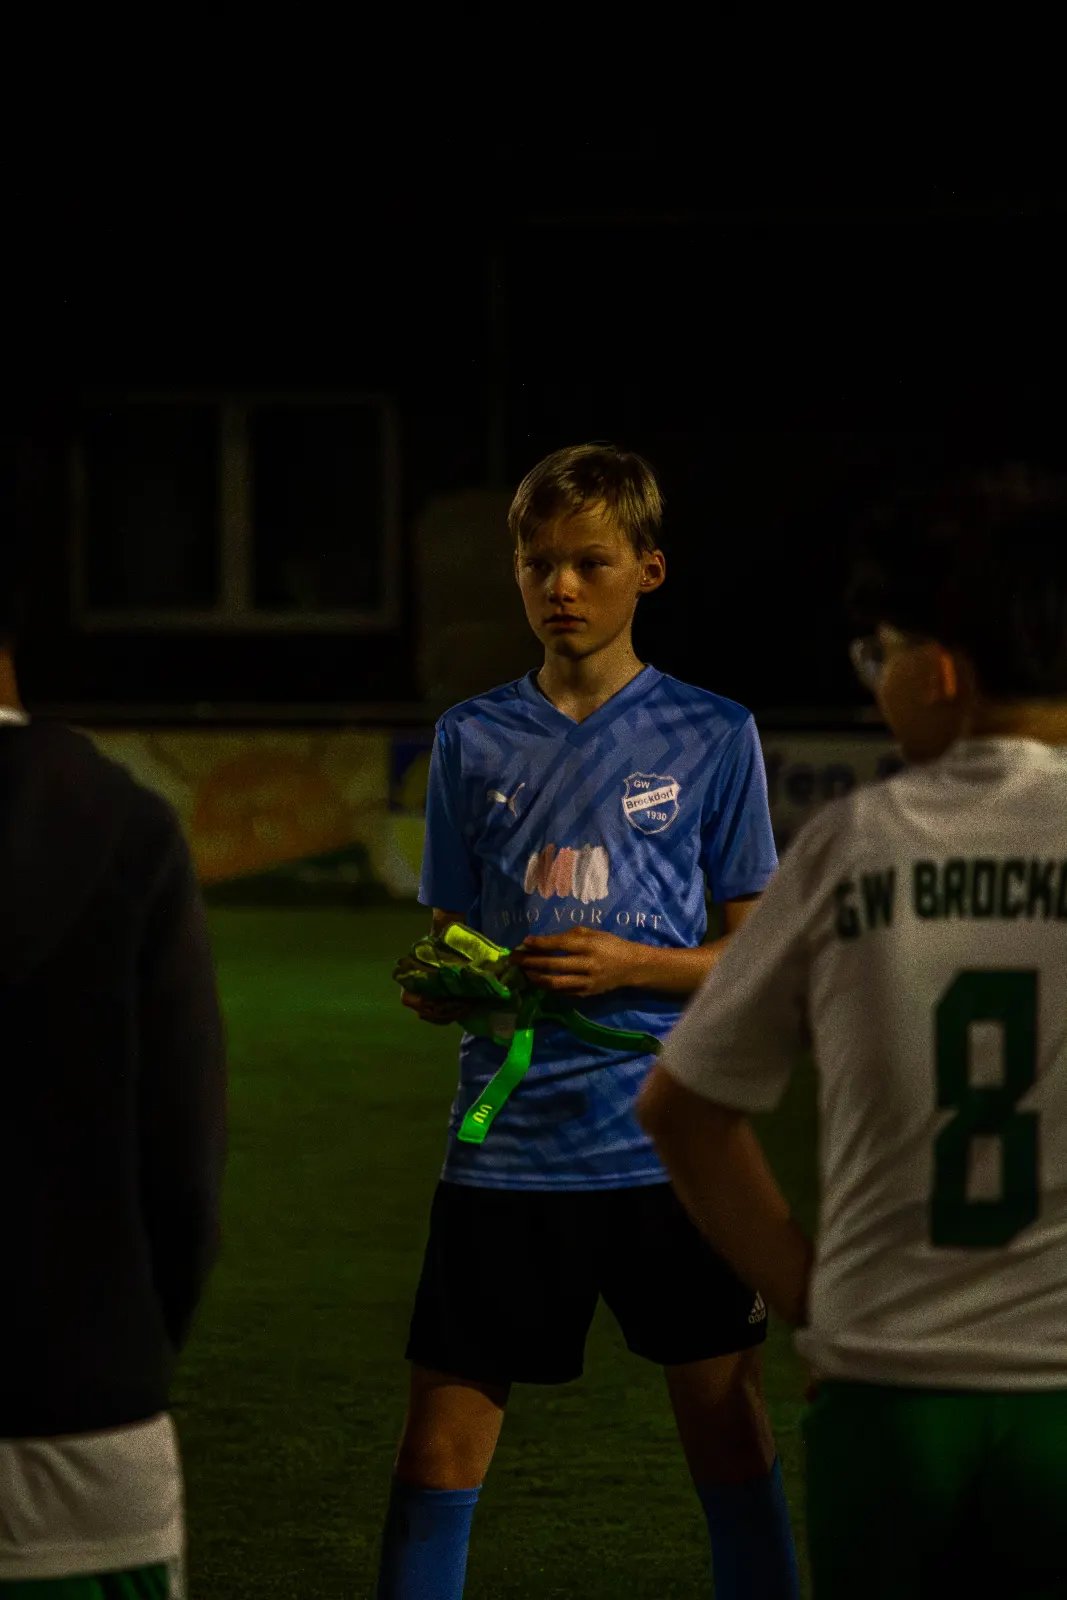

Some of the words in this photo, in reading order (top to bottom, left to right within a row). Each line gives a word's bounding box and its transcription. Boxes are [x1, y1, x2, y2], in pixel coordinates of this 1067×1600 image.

[633, 780, 651, 789] GW
[625, 788, 674, 810] Brockdorf
[646, 810, 667, 821] 1930
[833, 867, 895, 938] GW
[553, 906, 602, 925] VOR
[616, 911, 662, 930] ORT
[932, 970, 1038, 1246] 8
